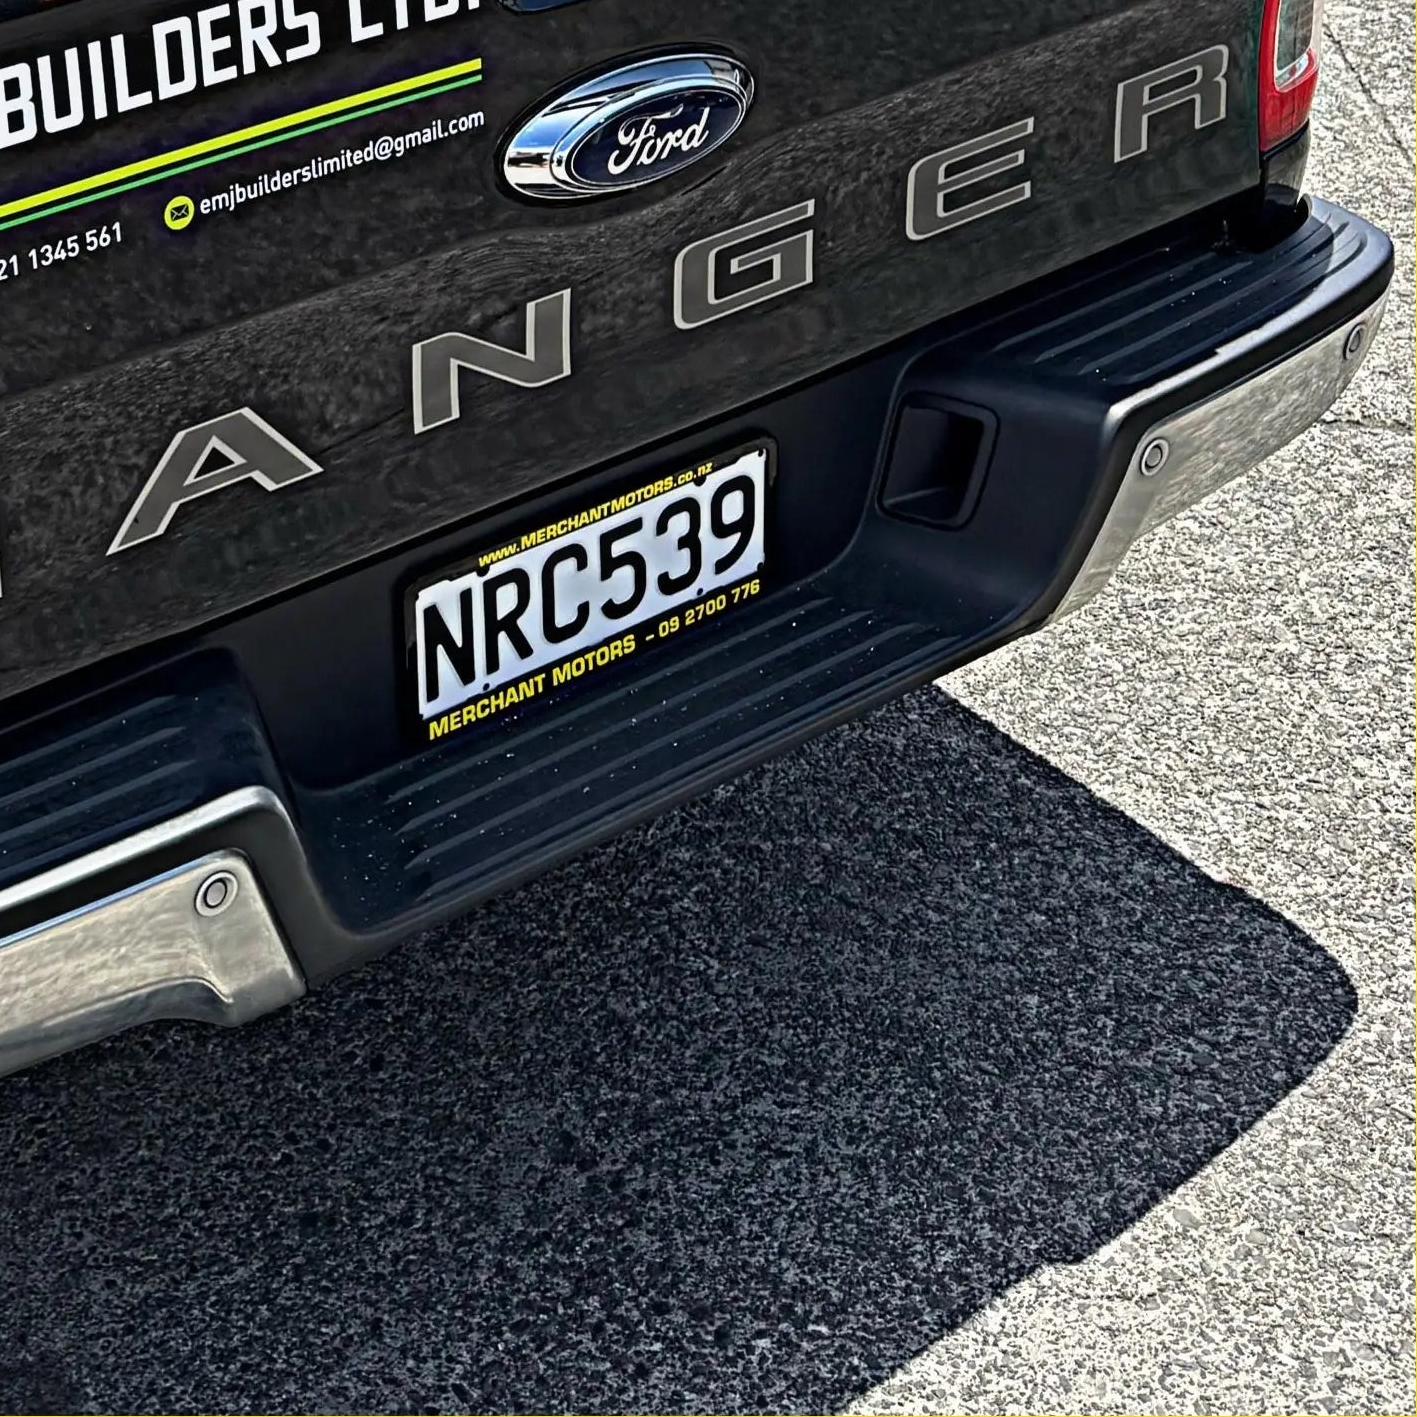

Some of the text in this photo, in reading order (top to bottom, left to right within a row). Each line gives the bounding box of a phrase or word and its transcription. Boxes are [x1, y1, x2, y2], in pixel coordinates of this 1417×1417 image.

[199, 109, 486, 215] emjbuilderslimited@gmail.com
[607, 103, 711, 175] Ford
[27, 235, 80, 270] 1345
[85, 221, 123, 251] 561
[478, 461, 713, 568] www.MERCHANTMOTORS.co.nz
[422, 475, 756, 702] NRC539
[428, 673, 546, 740] MERCHANT
[552, 633, 637, 687] MOTORS
[658, 615, 681, 639] 09
[685, 596, 727, 627] 2700
[732, 578, 762, 605] 776
